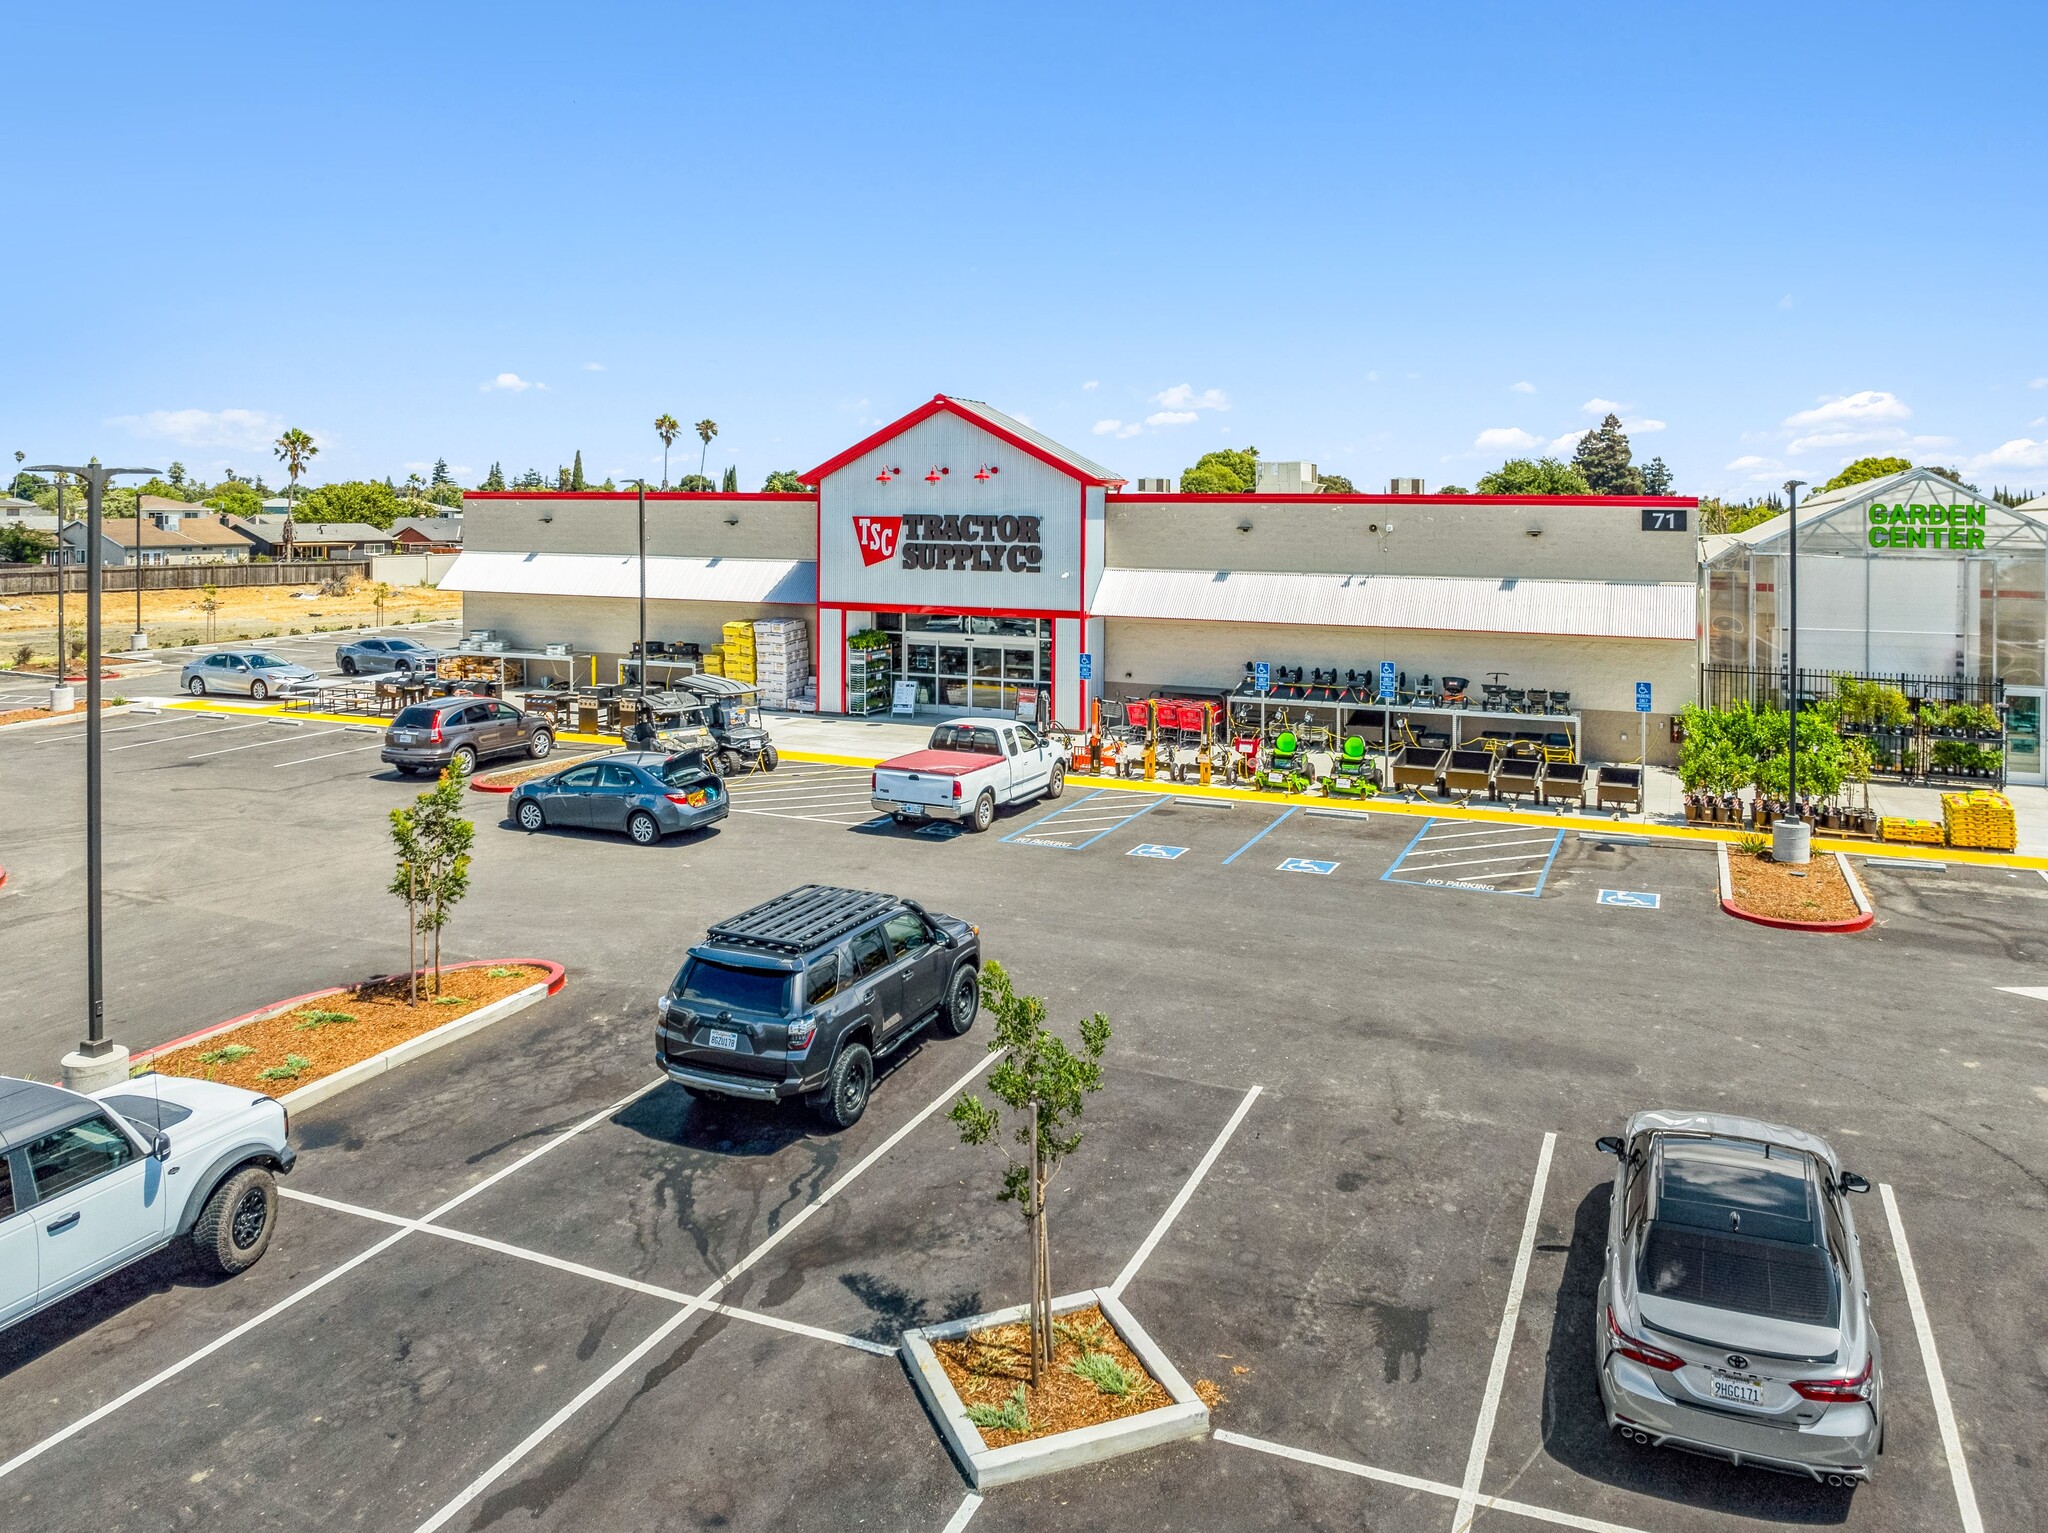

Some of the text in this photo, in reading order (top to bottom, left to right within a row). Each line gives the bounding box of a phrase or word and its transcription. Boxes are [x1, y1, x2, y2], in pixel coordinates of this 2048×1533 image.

[1652, 512, 1675, 529] 71
[1868, 503, 1986, 526] GARDEN
[858, 518, 893, 557] TSC
[902, 513, 1041, 543] TRACTOR
[1868, 526, 1986, 549] CENTER
[902, 543, 1006, 572] SUPPLY
[1446, 880, 1495, 891] PARKING
[1715, 1381, 1759, 1401] 9HGC171
